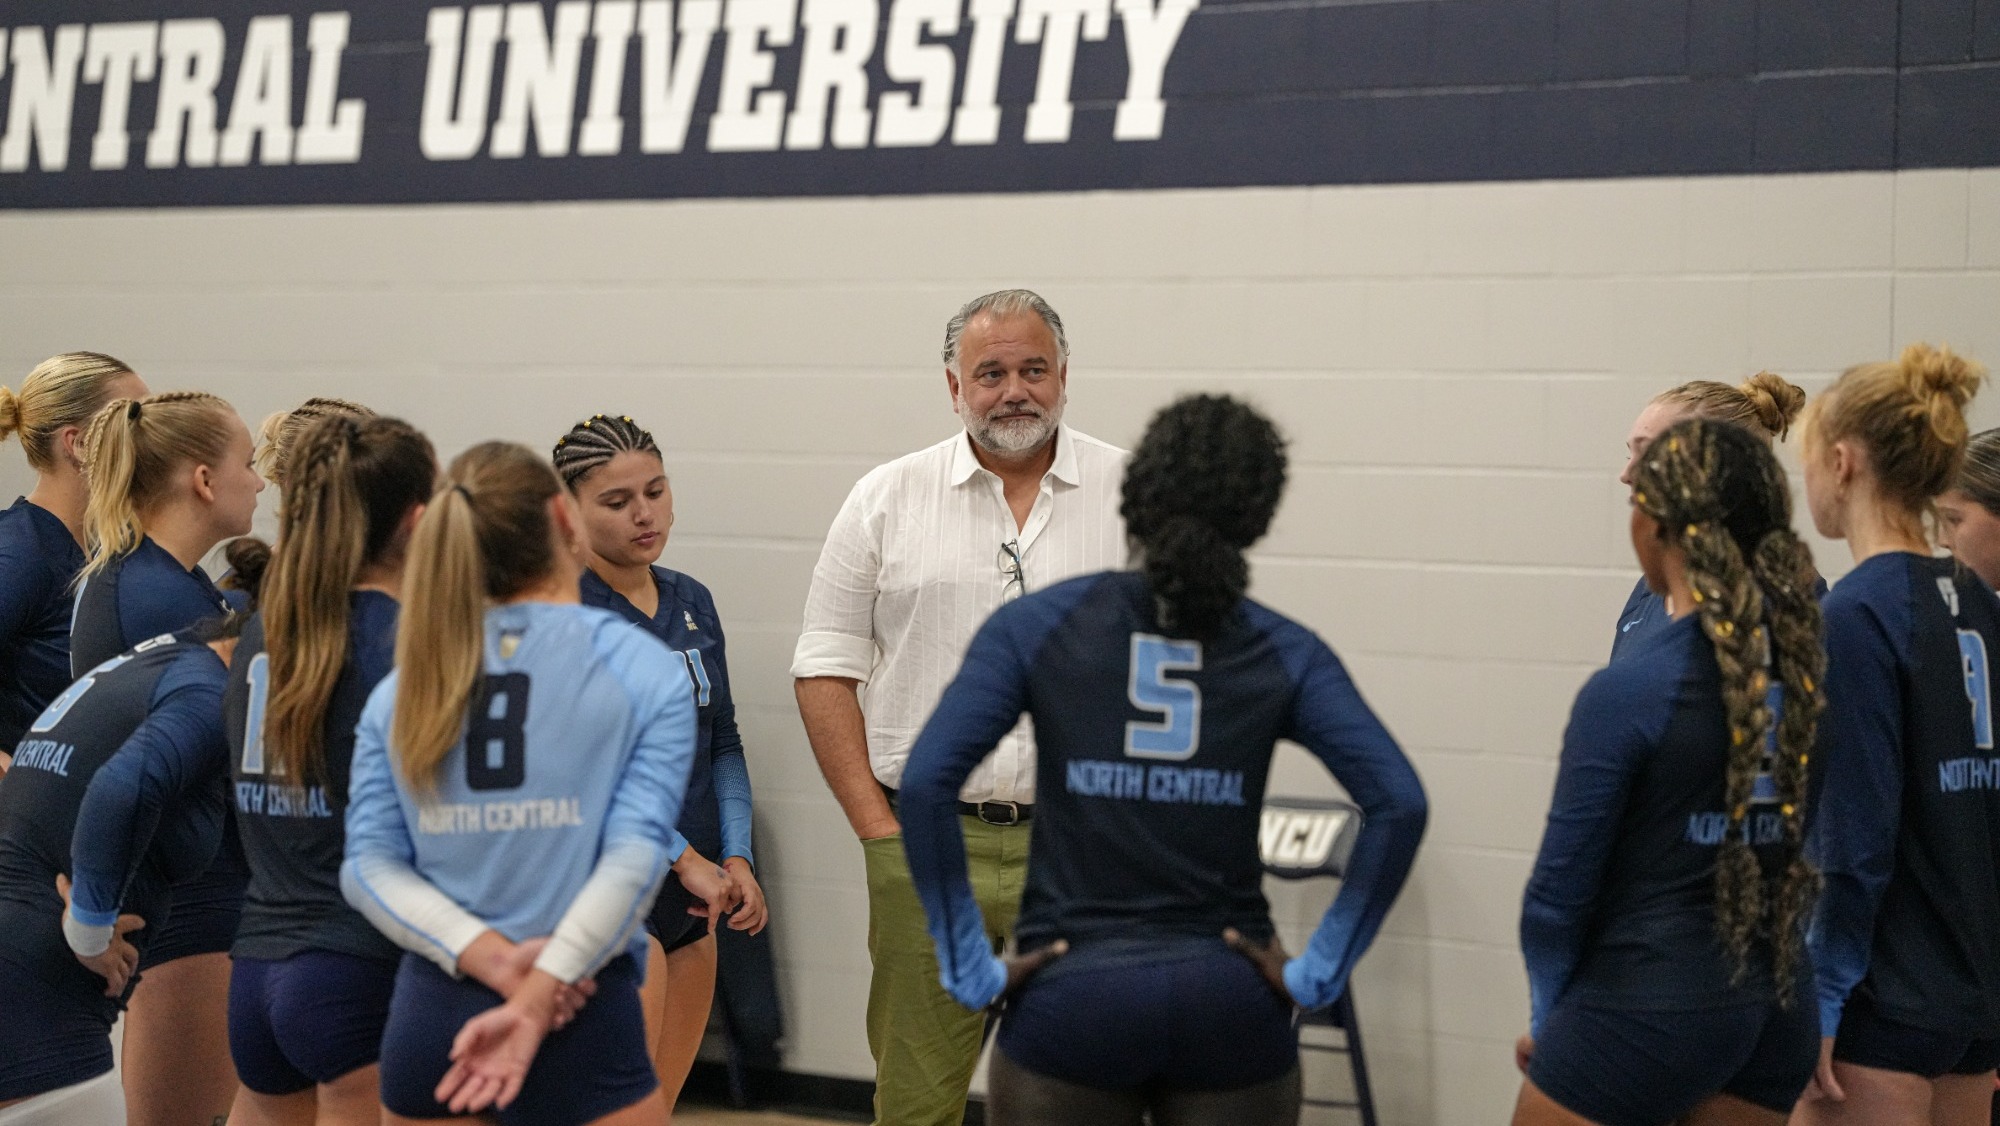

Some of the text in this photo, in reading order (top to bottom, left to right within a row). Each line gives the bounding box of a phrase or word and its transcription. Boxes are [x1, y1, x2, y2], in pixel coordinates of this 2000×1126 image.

[0, 0, 1199, 173] NTRAL UNIVERSITY
[465, 671, 531, 792] 8
[1124, 631, 1202, 761] 5
[418, 797, 584, 835] NORTH CENTRAL
[1065, 759, 1245, 806] NORTH CENTRAL
